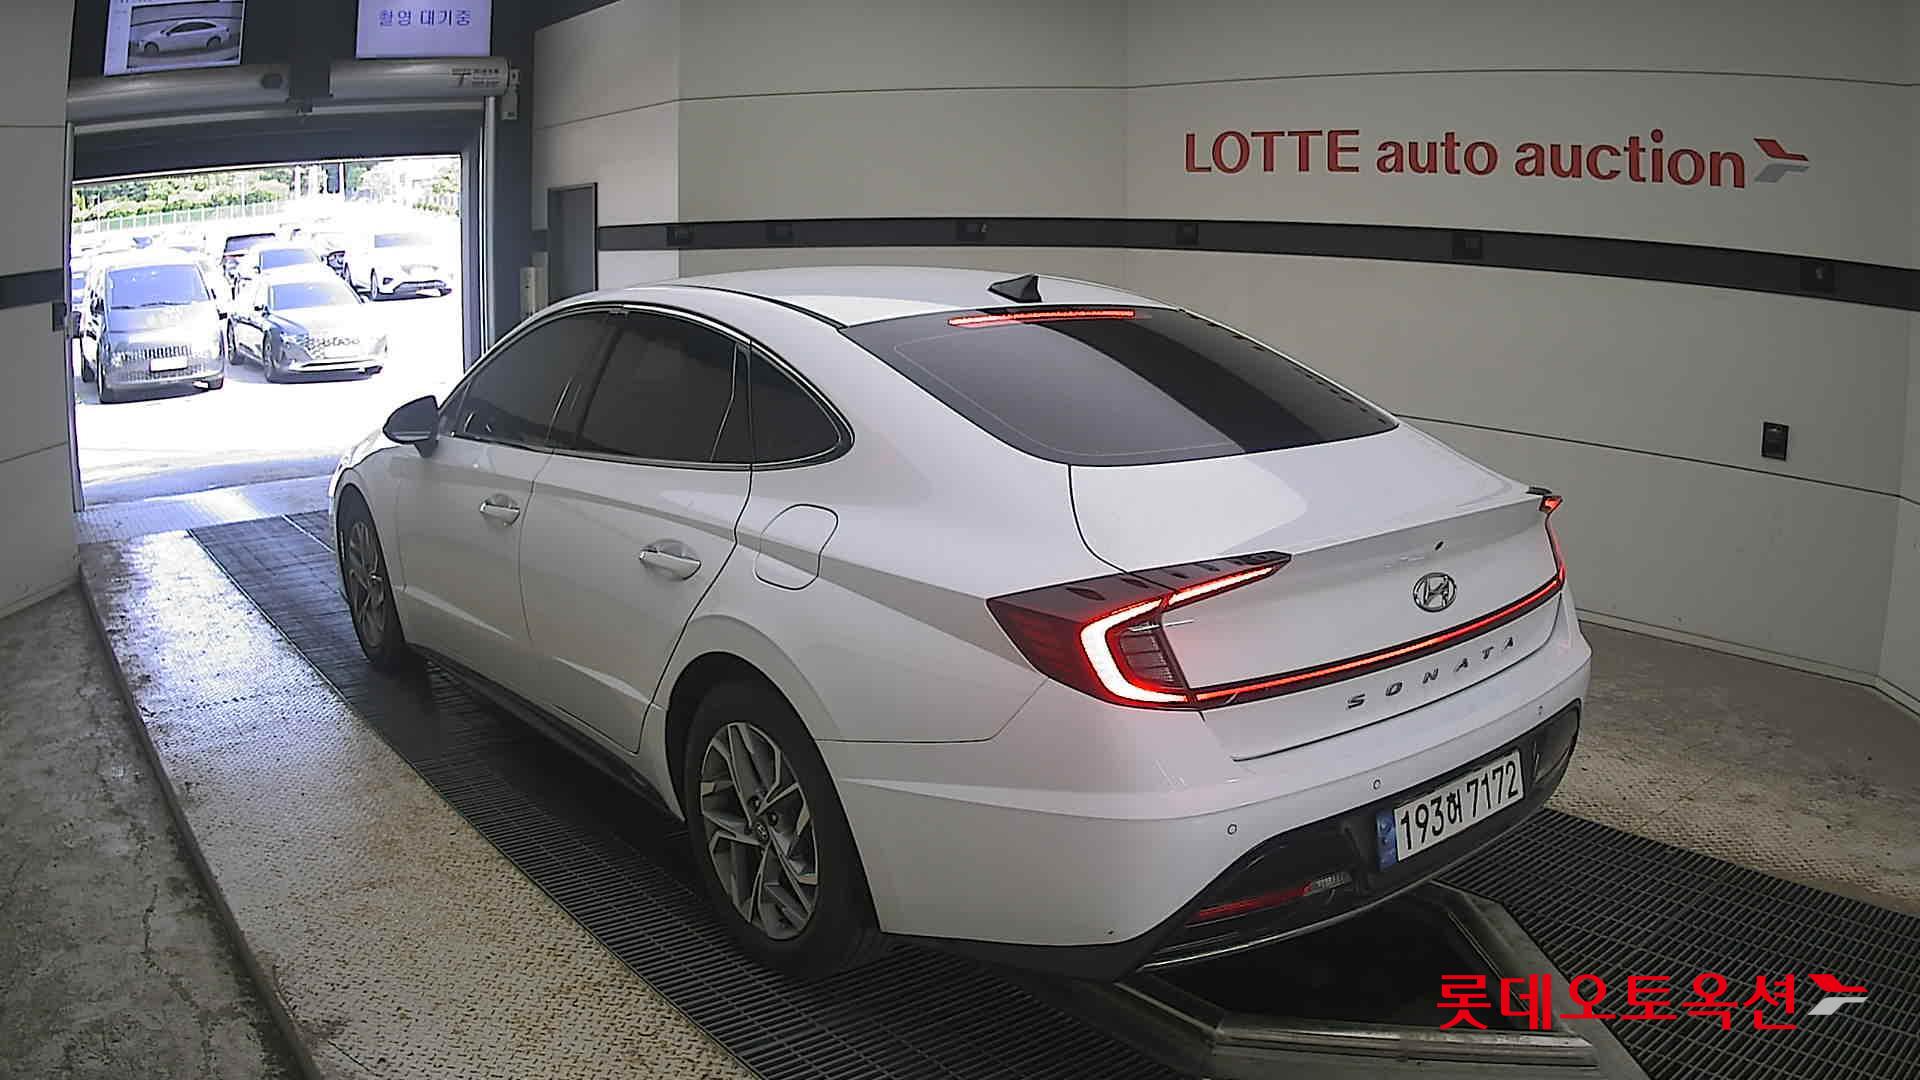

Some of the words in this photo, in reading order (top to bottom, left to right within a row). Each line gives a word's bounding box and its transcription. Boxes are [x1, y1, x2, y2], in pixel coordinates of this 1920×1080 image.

[420, 9, 471, 27] 대기중
[1185, 130, 1360, 174] LOTTE
[1376, 131, 1499, 176] auto
[1514, 129, 1746, 189] auction
[1347, 636, 1515, 709] SONATA
